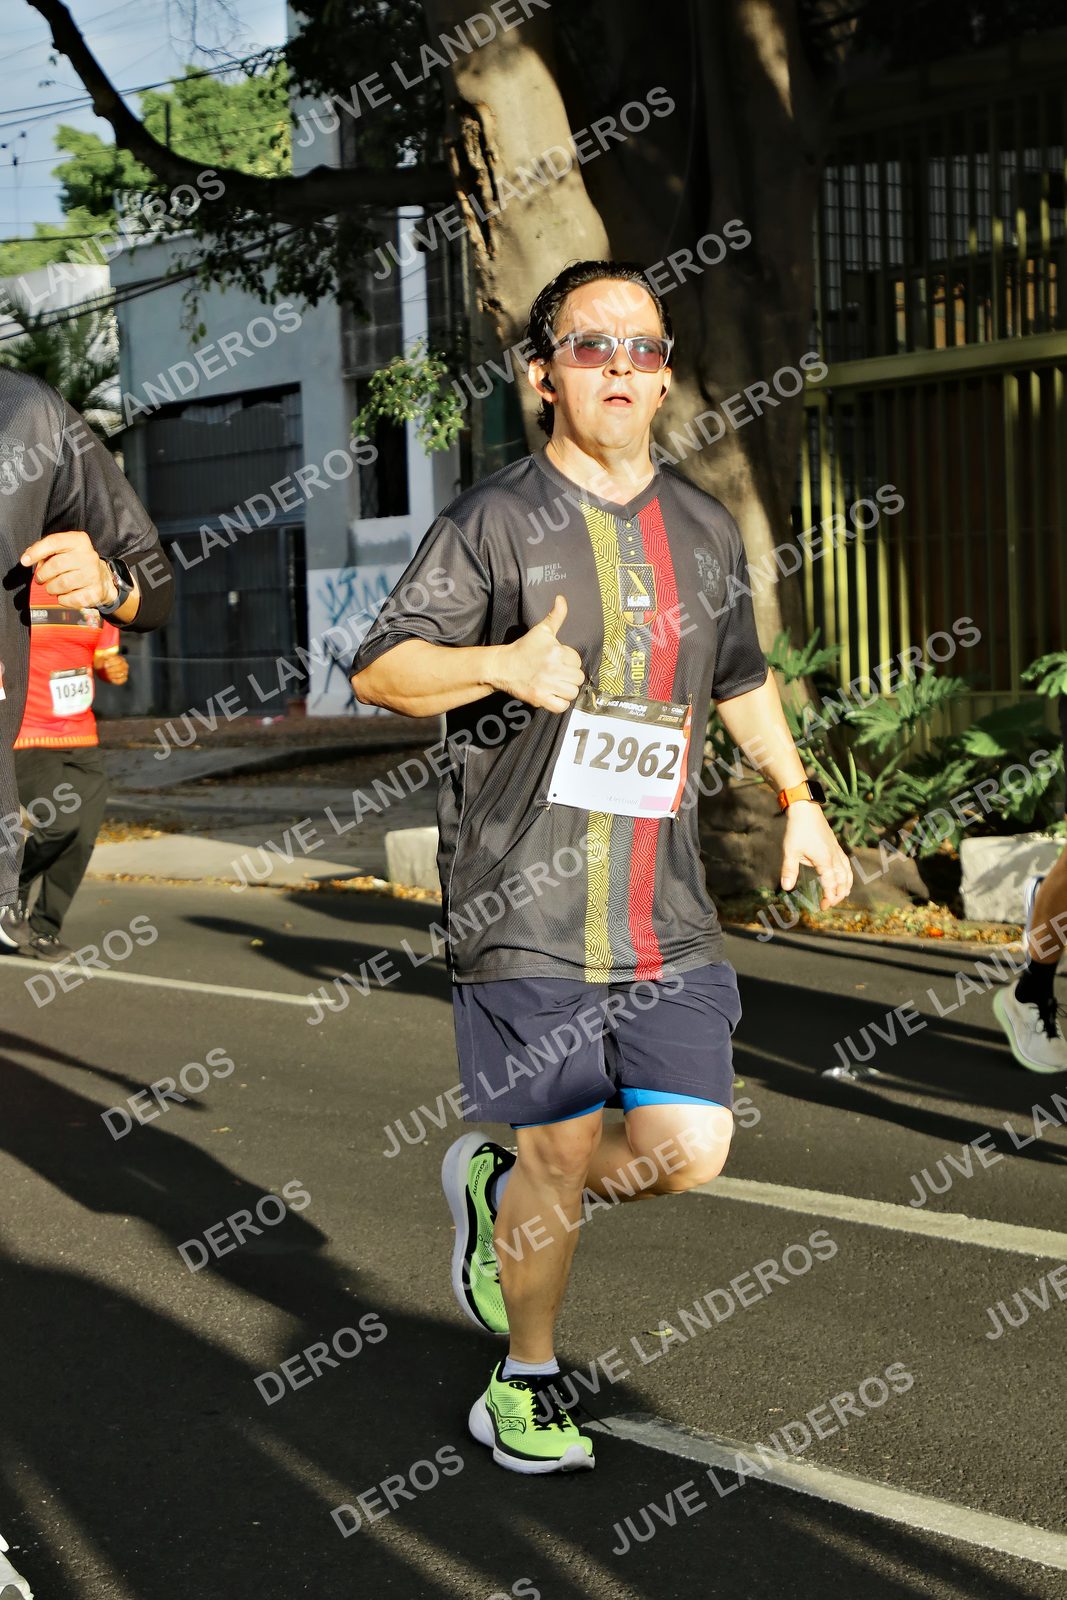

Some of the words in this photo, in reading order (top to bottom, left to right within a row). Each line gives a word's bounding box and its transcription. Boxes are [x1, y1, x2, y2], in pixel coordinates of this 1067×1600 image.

[544, 562, 562, 570] PIEL
[56, 681, 90, 699] 10345
[573, 728, 680, 780] 12962
[472, 1159, 488, 1197] saucony
